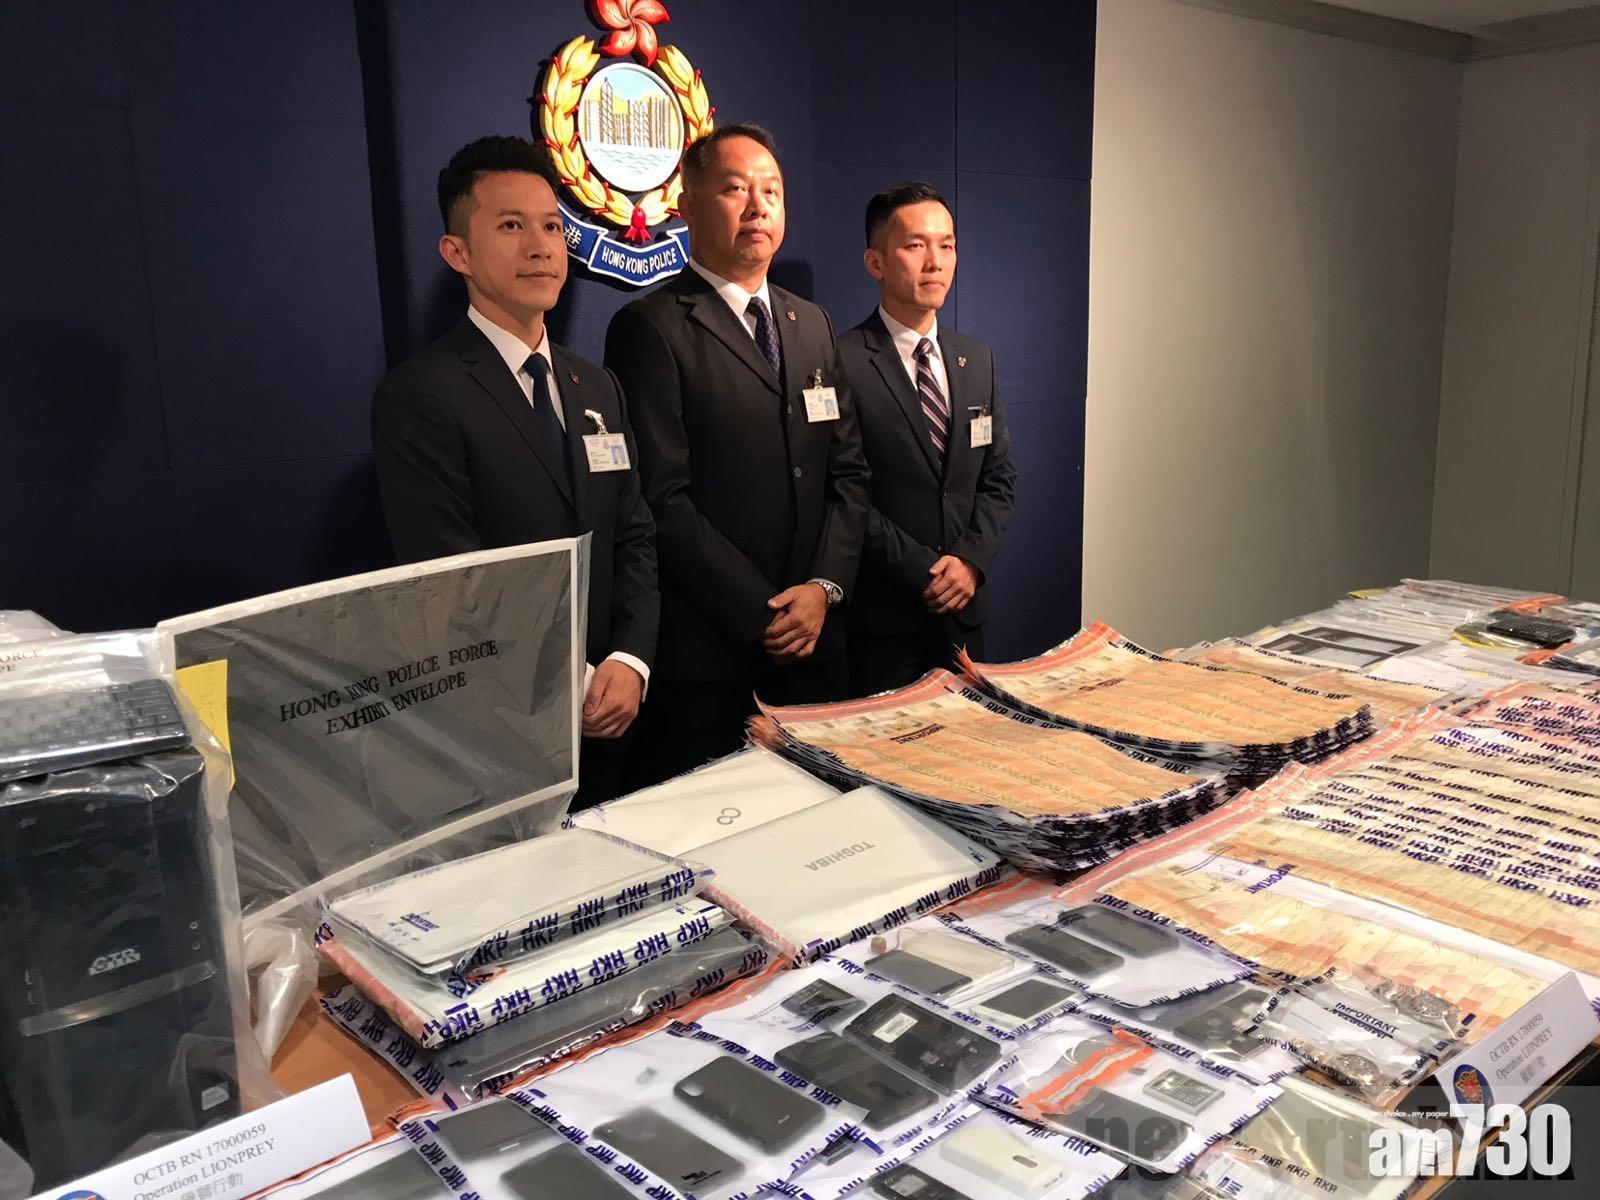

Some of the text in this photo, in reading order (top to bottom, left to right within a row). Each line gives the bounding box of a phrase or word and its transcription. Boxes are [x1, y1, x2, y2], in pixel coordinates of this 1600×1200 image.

[602, 246, 677, 275] HONG KONG POLICE
[279, 640, 498, 722] HONG KONG POLICE FORCE
[326, 672, 467, 735] EXHIBIT ENVELOPE
[804, 841, 875, 873] TOSHIBA
[1244, 862, 1298, 895] IMPORTANT
[837, 958, 864, 975] HKP
[1335, 1002, 1399, 1034] IMPORTANT
[133, 1123, 266, 1187] OCTB RN 17000059
[1064, 1135, 1101, 1157] HKP
[133, 1138, 276, 1200] Operation LIONPREY
